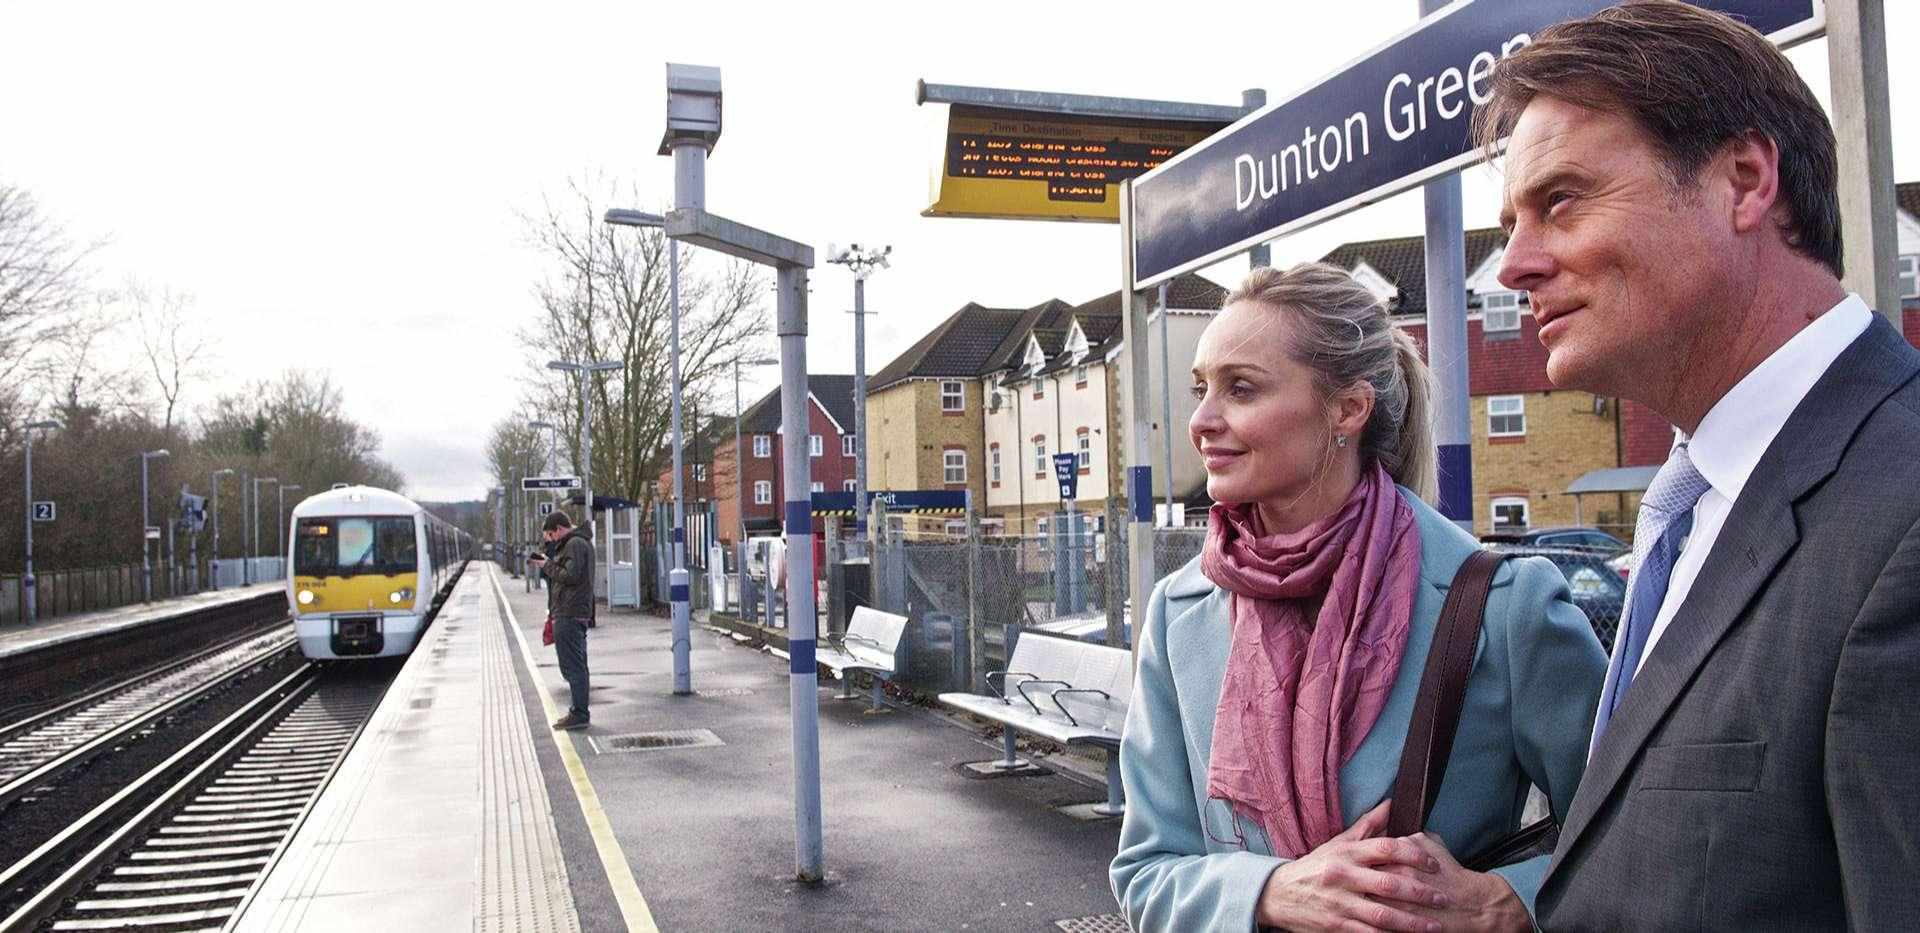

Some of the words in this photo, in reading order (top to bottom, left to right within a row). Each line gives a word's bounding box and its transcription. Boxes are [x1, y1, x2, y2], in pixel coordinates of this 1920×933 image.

[993, 121, 1018, 133] Time
[1023, 123, 1083, 138] Destination
[1234, 111, 1369, 212] Dunton
[875, 492, 896, 504] Exit
[40, 504, 49, 518] 2
